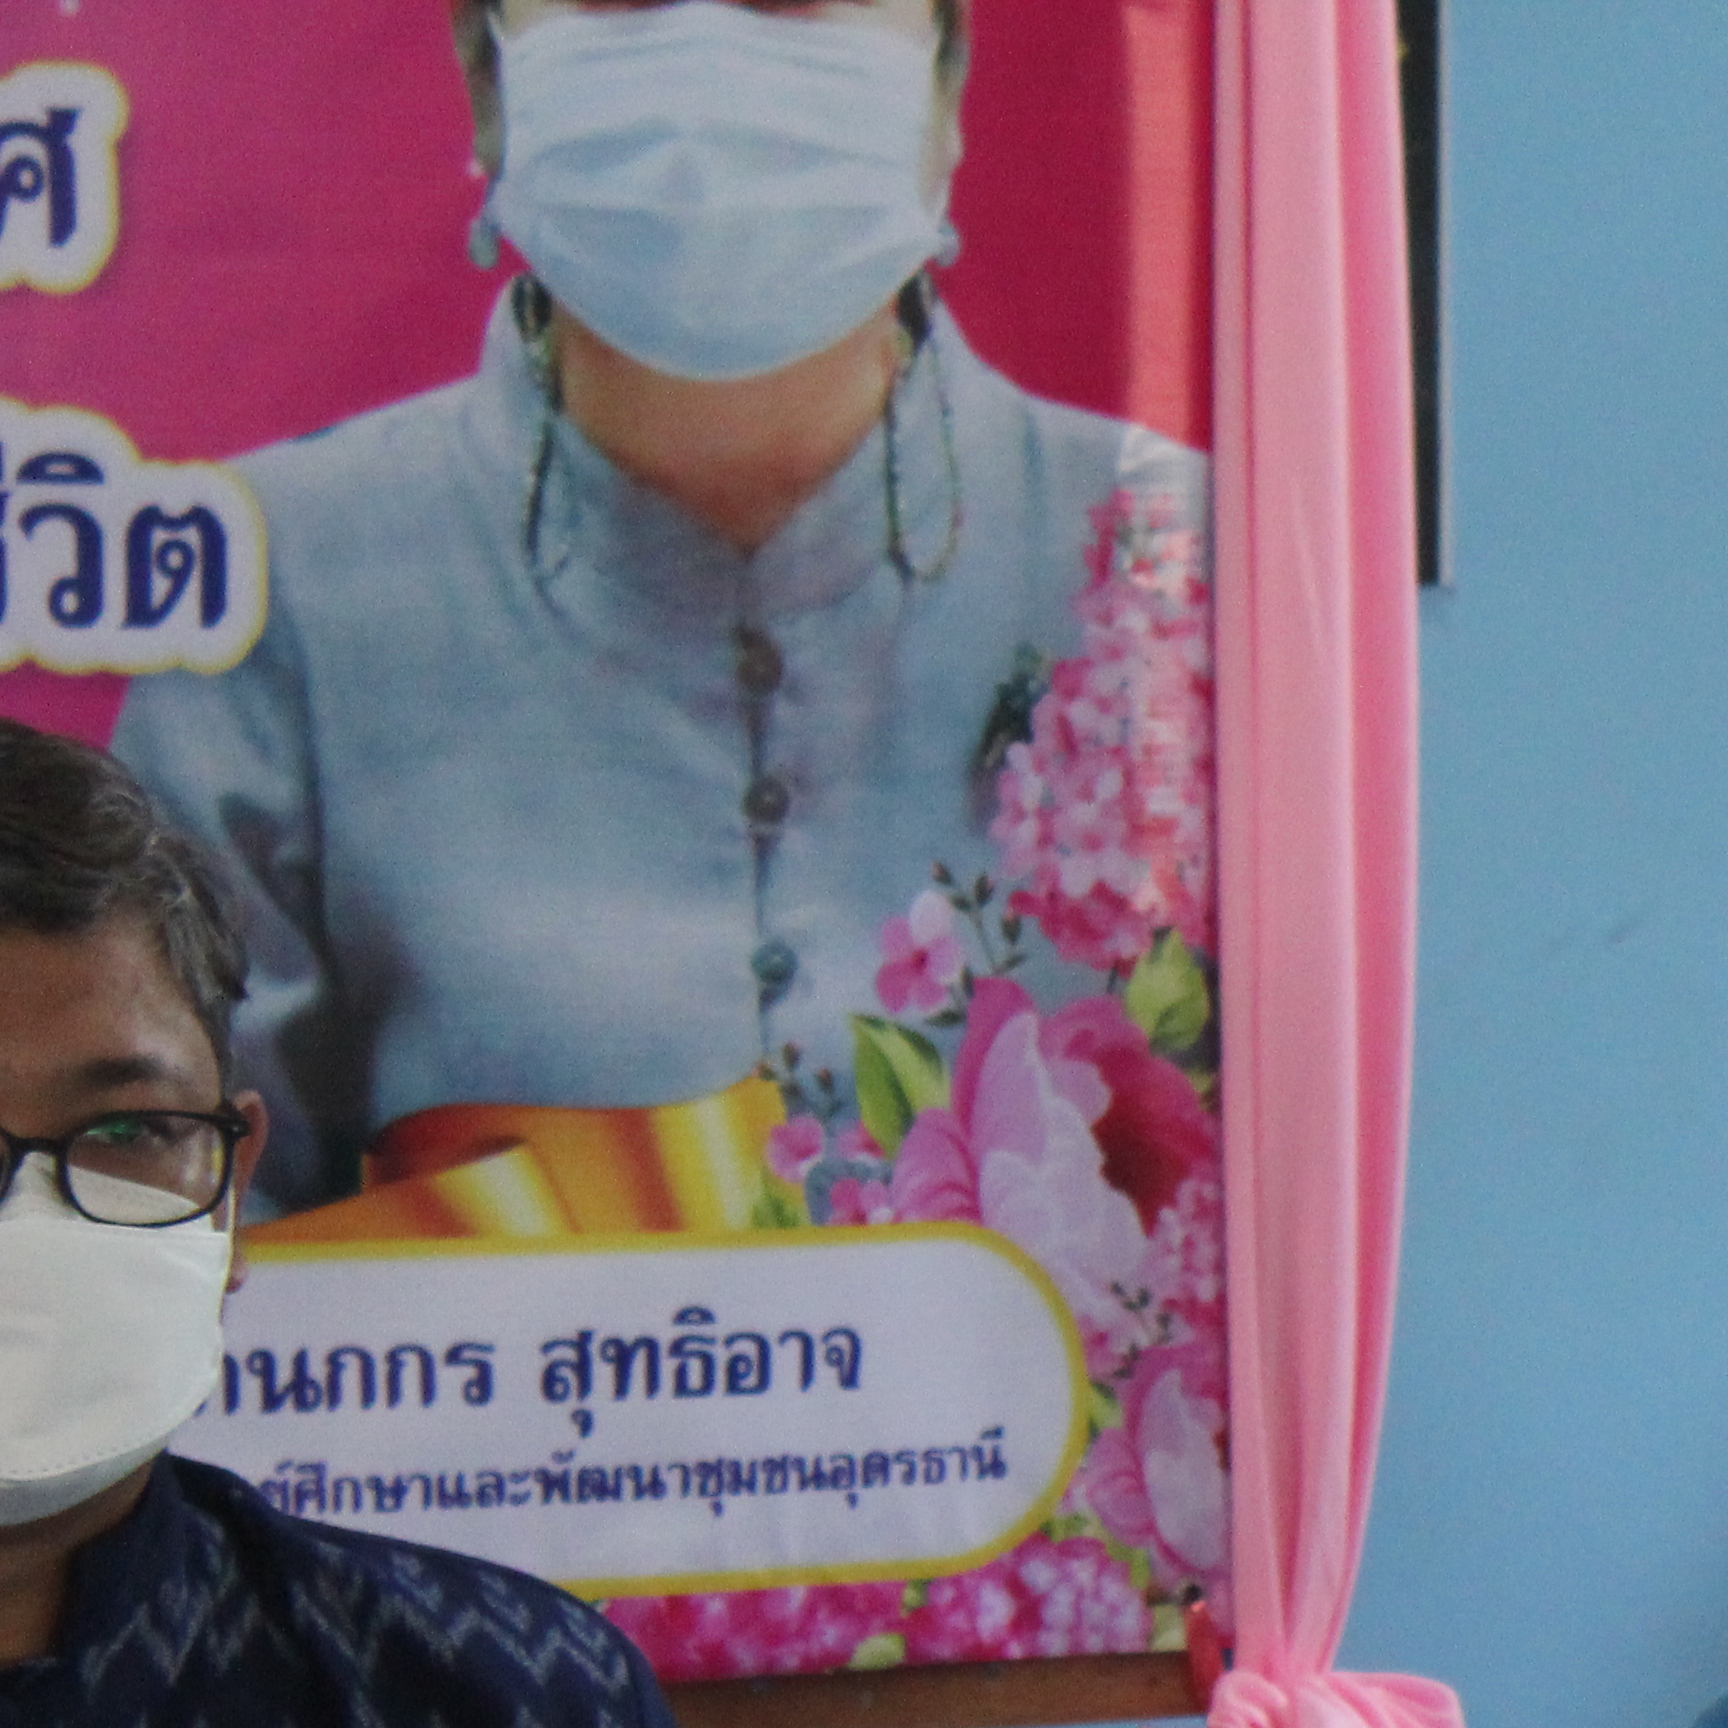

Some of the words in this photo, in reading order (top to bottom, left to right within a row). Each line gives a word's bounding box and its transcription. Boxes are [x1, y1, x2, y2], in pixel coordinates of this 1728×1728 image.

[0, 441, 228, 628] วิต
[540, 1306, 862, 1438] สุทธิอาจ
